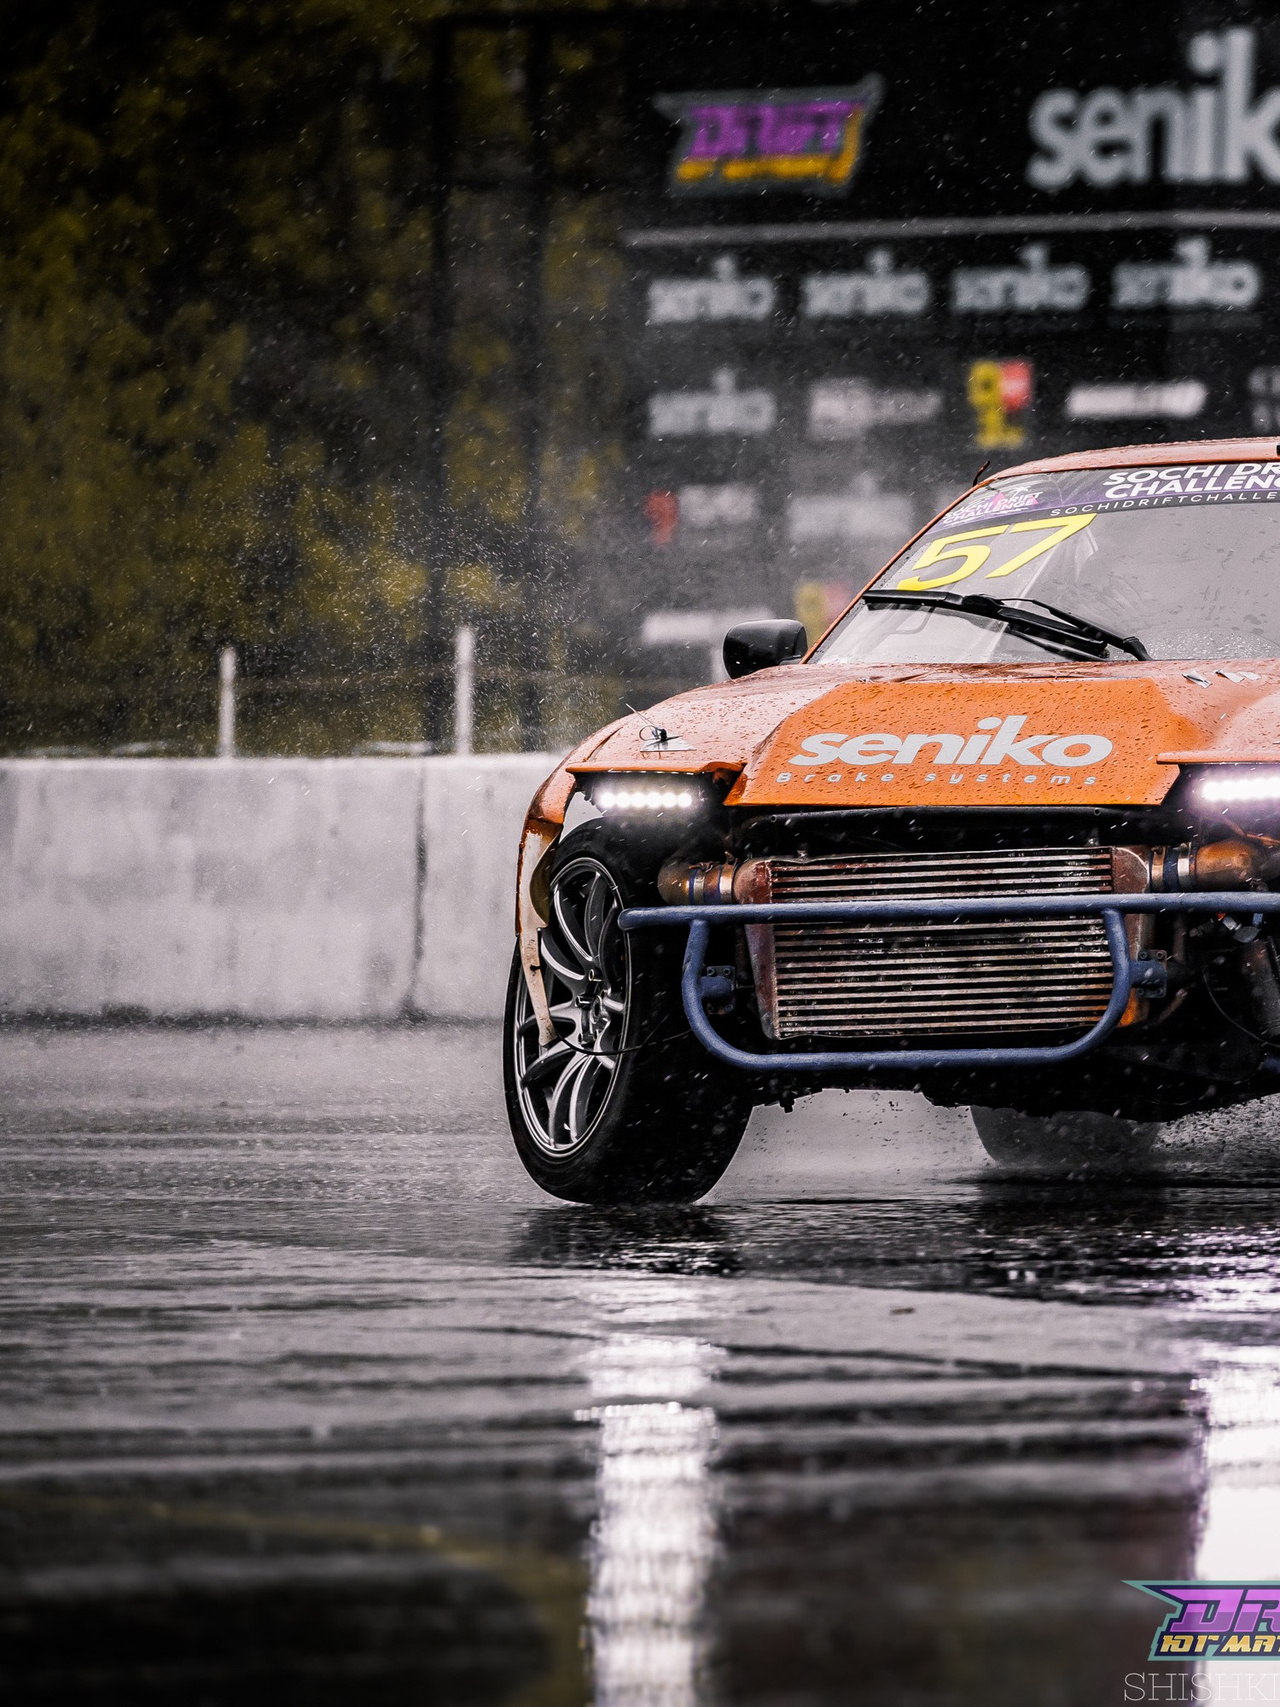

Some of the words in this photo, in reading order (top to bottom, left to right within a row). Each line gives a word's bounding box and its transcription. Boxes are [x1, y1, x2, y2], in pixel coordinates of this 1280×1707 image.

[1104, 464, 1226, 486] SOCHI
[943, 500, 1034, 524] CHALLENGE
[896, 513, 1097, 591] 57
[788, 715, 1113, 767] seniko
[776, 770, 895, 783] Brake
[925, 771, 1096, 785] systems
